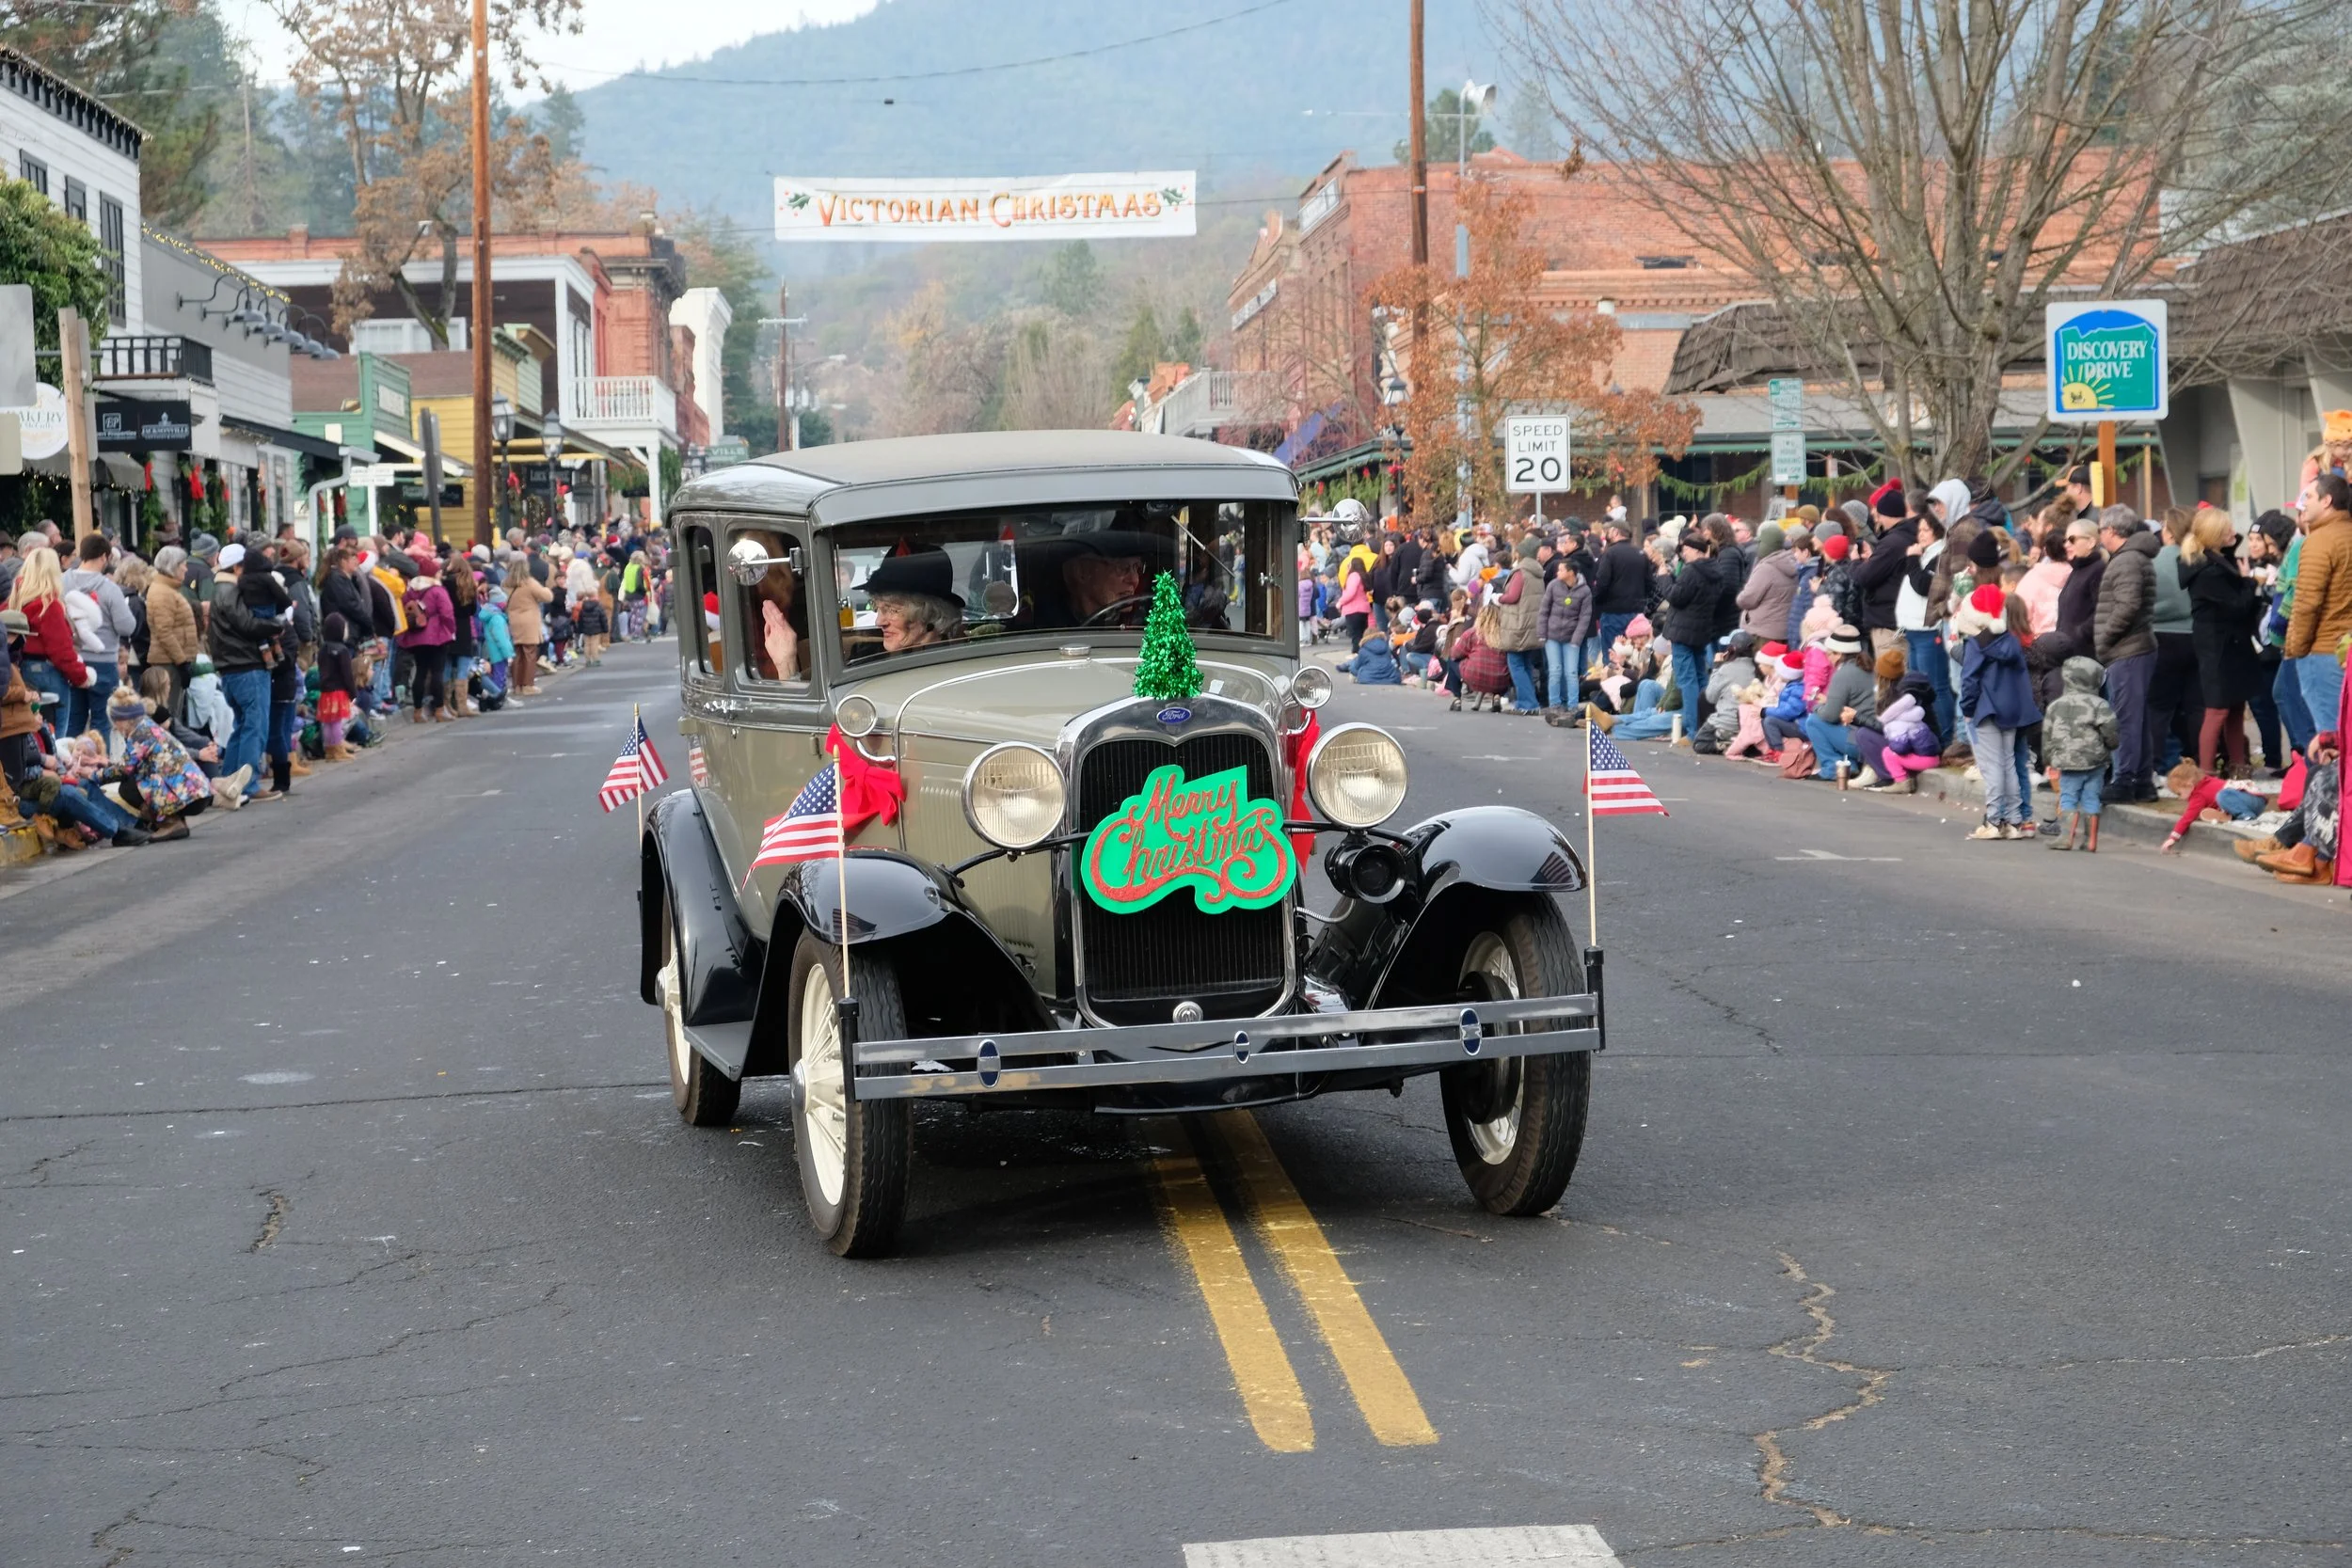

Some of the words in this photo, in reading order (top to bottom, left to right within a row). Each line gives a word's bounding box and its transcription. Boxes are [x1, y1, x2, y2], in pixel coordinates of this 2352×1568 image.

[817, 193, 979, 227] VICTORIAN
[988, 191, 1162, 228] CHRISTMAS
[2067, 340, 2147, 360] DISCOVERY
[2084, 361, 2134, 379] DRIVE
[1513, 425, 1563, 436] SPEED
[1518, 439, 1558, 452] LIMIT
[1515, 456, 1562, 483] 20
[1161, 709, 1186, 721] Ford
[1129, 773, 1238, 830] Merry
[1089, 807, 1288, 903] Christmas
